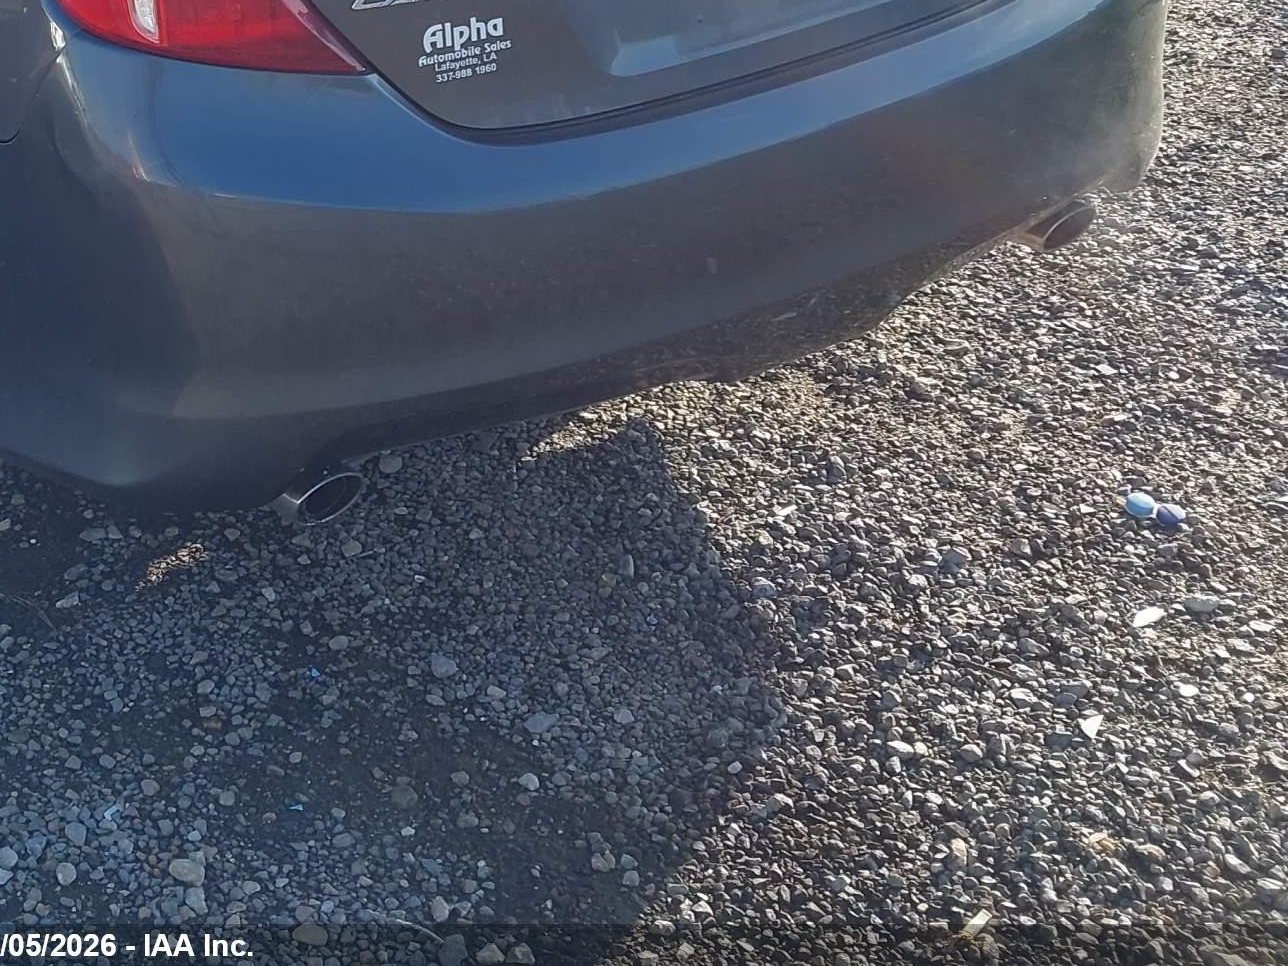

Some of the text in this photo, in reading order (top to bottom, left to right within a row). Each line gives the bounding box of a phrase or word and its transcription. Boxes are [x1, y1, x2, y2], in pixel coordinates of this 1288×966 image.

[423, 16, 504, 54] Alpha
[418, 40, 512, 67] Automobile Sales
[435, 52, 498, 71] Lafayette, LA
[436, 63, 497, 83] 337-988 1960
